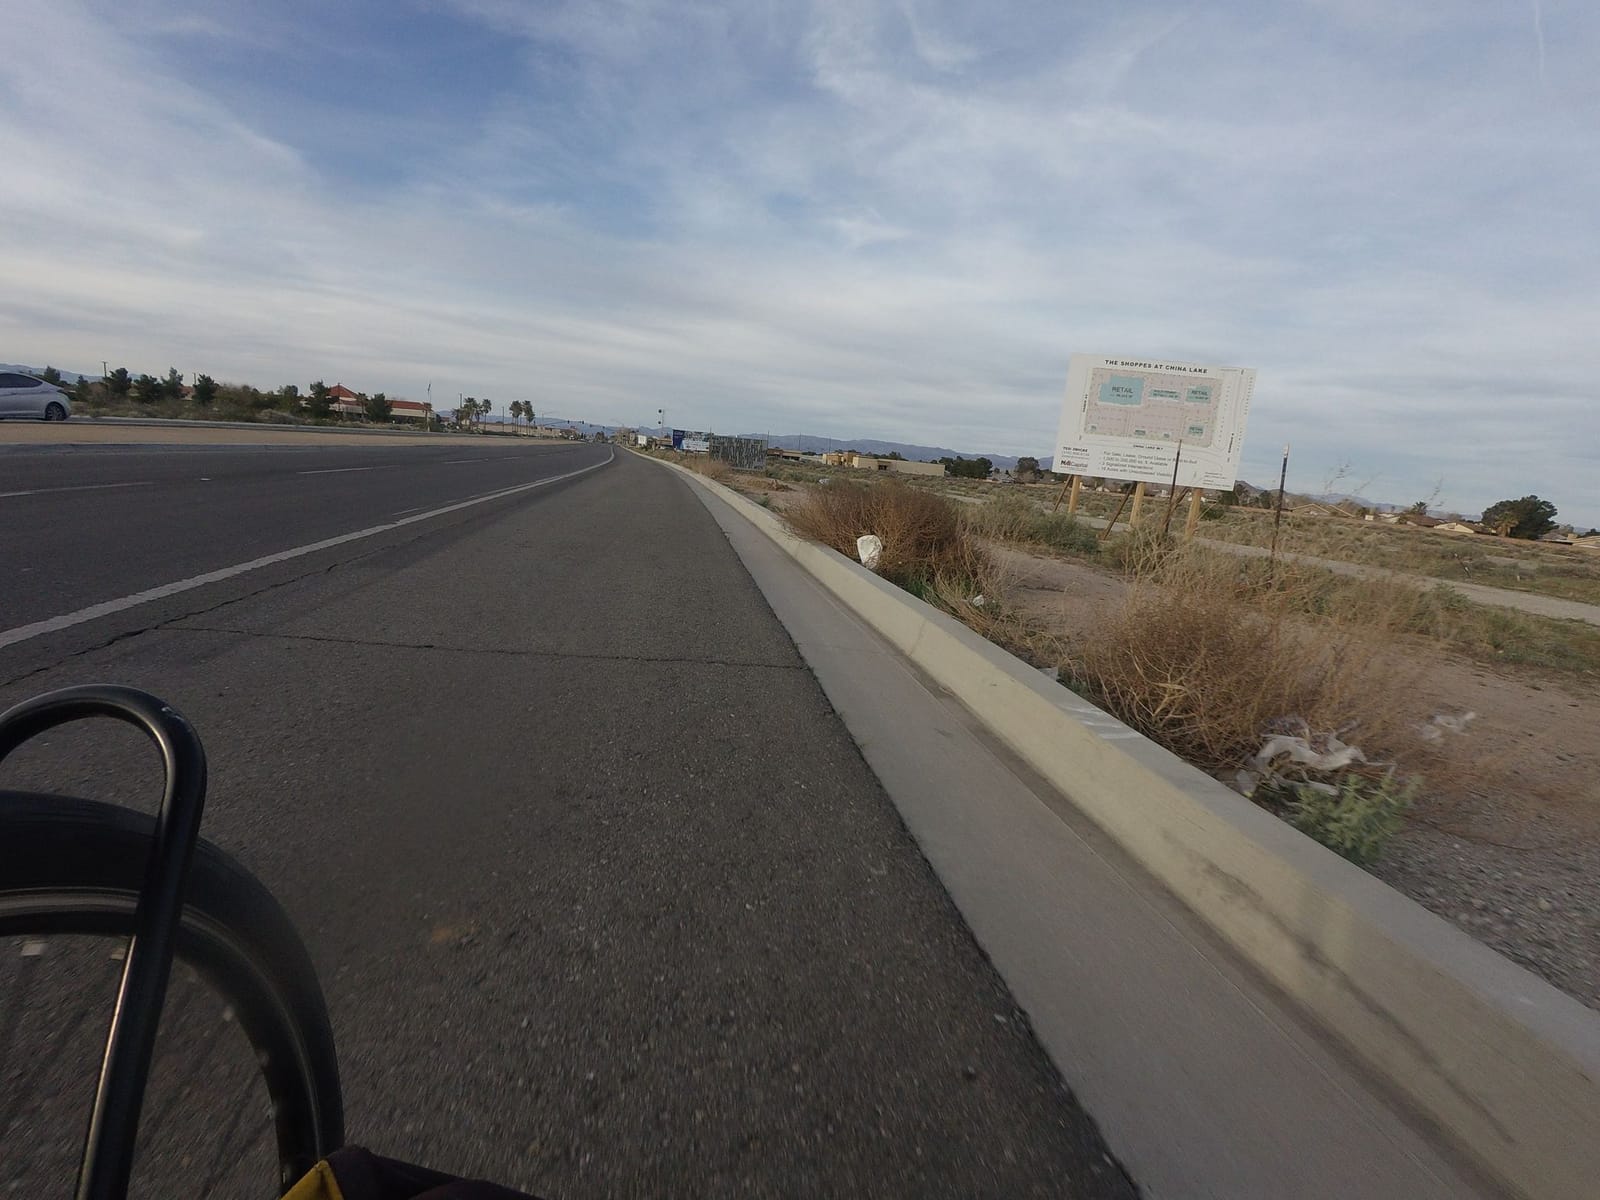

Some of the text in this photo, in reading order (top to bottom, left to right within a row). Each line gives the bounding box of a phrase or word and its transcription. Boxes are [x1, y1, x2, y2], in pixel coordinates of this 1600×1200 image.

[1120, 361, 1152, 369] SHOPPES
[1165, 365, 1187, 373] CHINA
[1111, 386, 1134, 394] RETAIL
